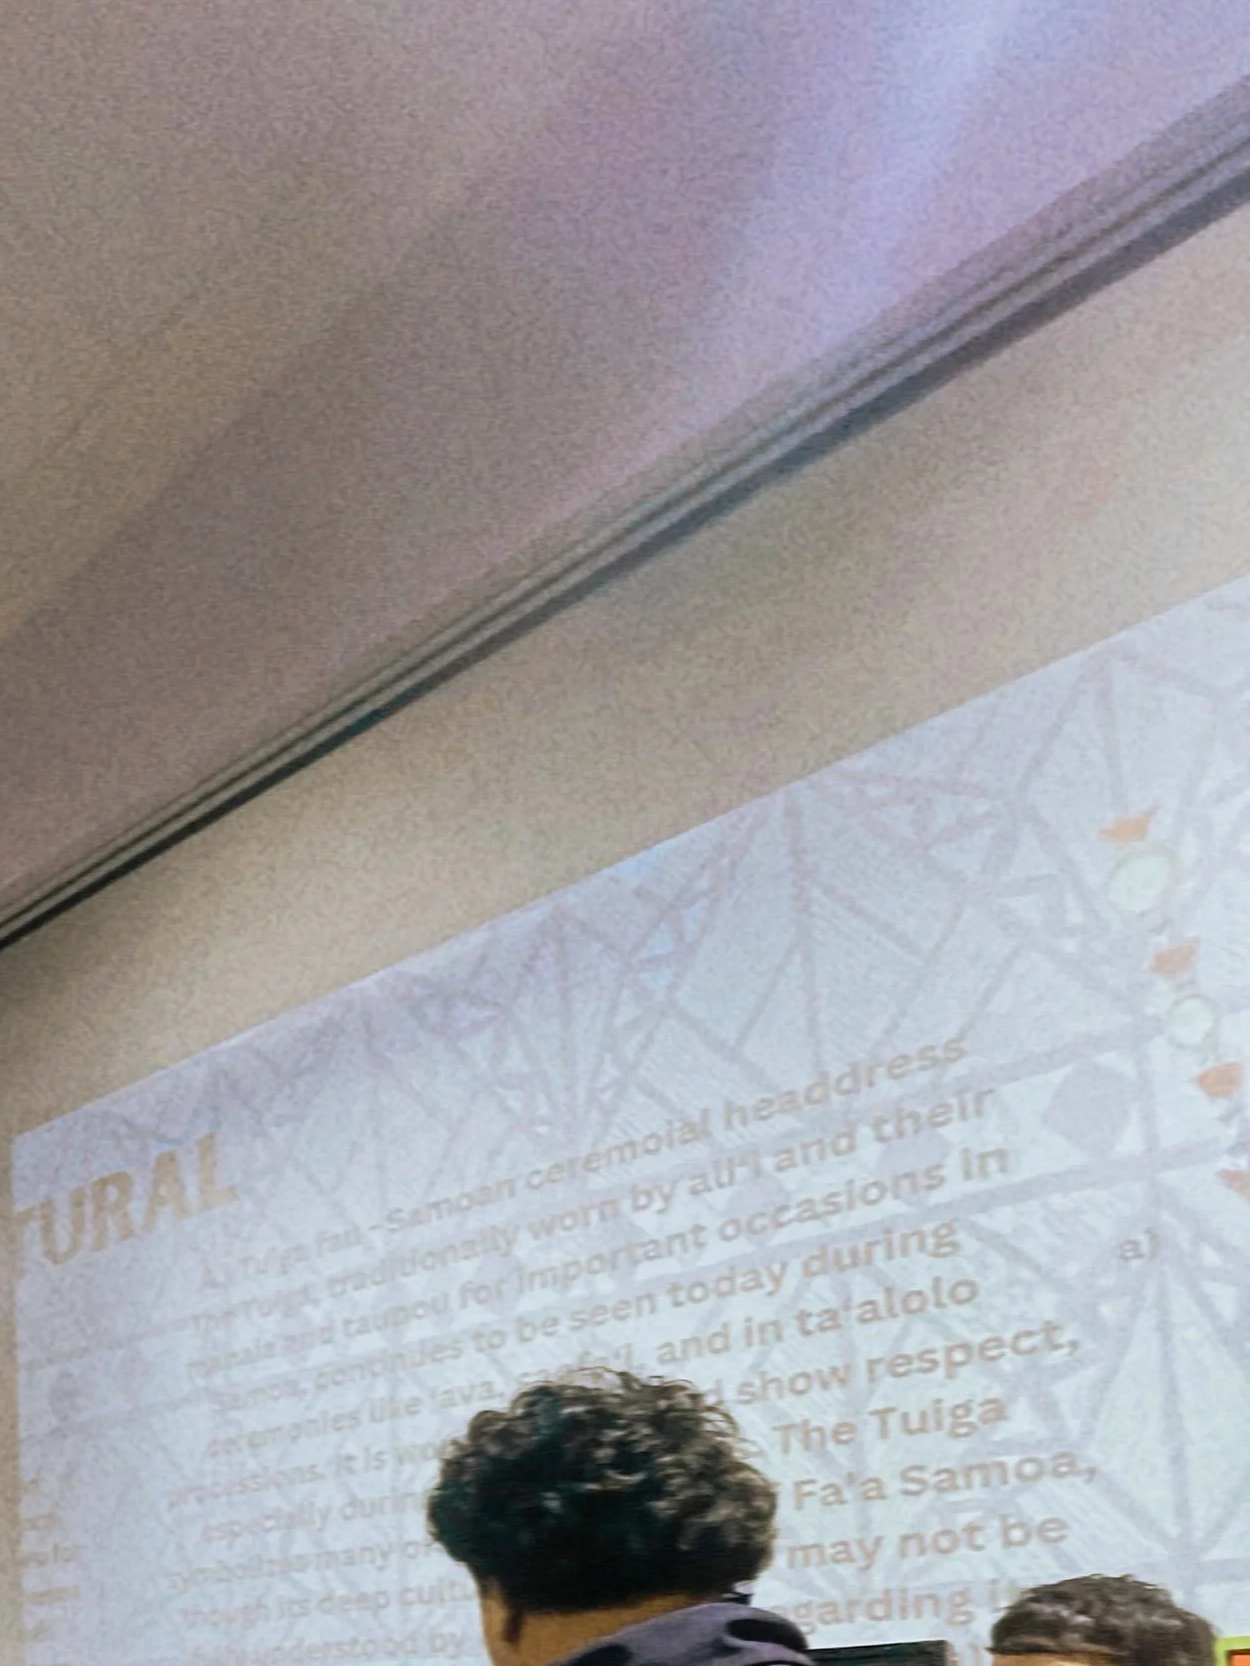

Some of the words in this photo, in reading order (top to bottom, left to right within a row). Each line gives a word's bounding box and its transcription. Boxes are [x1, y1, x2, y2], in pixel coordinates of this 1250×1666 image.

[383, 1177, 517, 1234] Samoan
[525, 1108, 712, 1191] ceremoial
[723, 1035, 967, 1131] headdress
[327, 1225, 519, 1299] traditionally
[529, 1197, 621, 1240] worn
[631, 1180, 676, 1216] by
[775, 1112, 858, 1173] and
[872, 1086, 995, 1143] their
[459, 1279, 506, 1310] for
[516, 1223, 707, 1292] important
[718, 1163, 947, 1241] occasions
[962, 1146, 1009, 1182] in
[471, 1328, 508, 1356] to
[515, 1313, 561, 1345] be
[570, 1289, 658, 1331] seen
[666, 1260, 789, 1308] today
[802, 1217, 964, 1279] during
[656, 1320, 731, 1366] and
[743, 1315, 784, 1349] in
[793, 1275, 981, 1337] ta'alolo
[736, 1364, 853, 1406] show
[866, 1319, 1081, 1383] respect,
[771, 1418, 858, 1454] The
[868, 1395, 1010, 1442] Tuiga
[793, 1472, 888, 1511] Fa'a
[899, 1451, 1098, 1499] Samoa,
[786, 1532, 885, 1573] may
[897, 1520, 986, 1559] not
[999, 1512, 1070, 1549] be
[770, 1586, 976, 1636] garding
